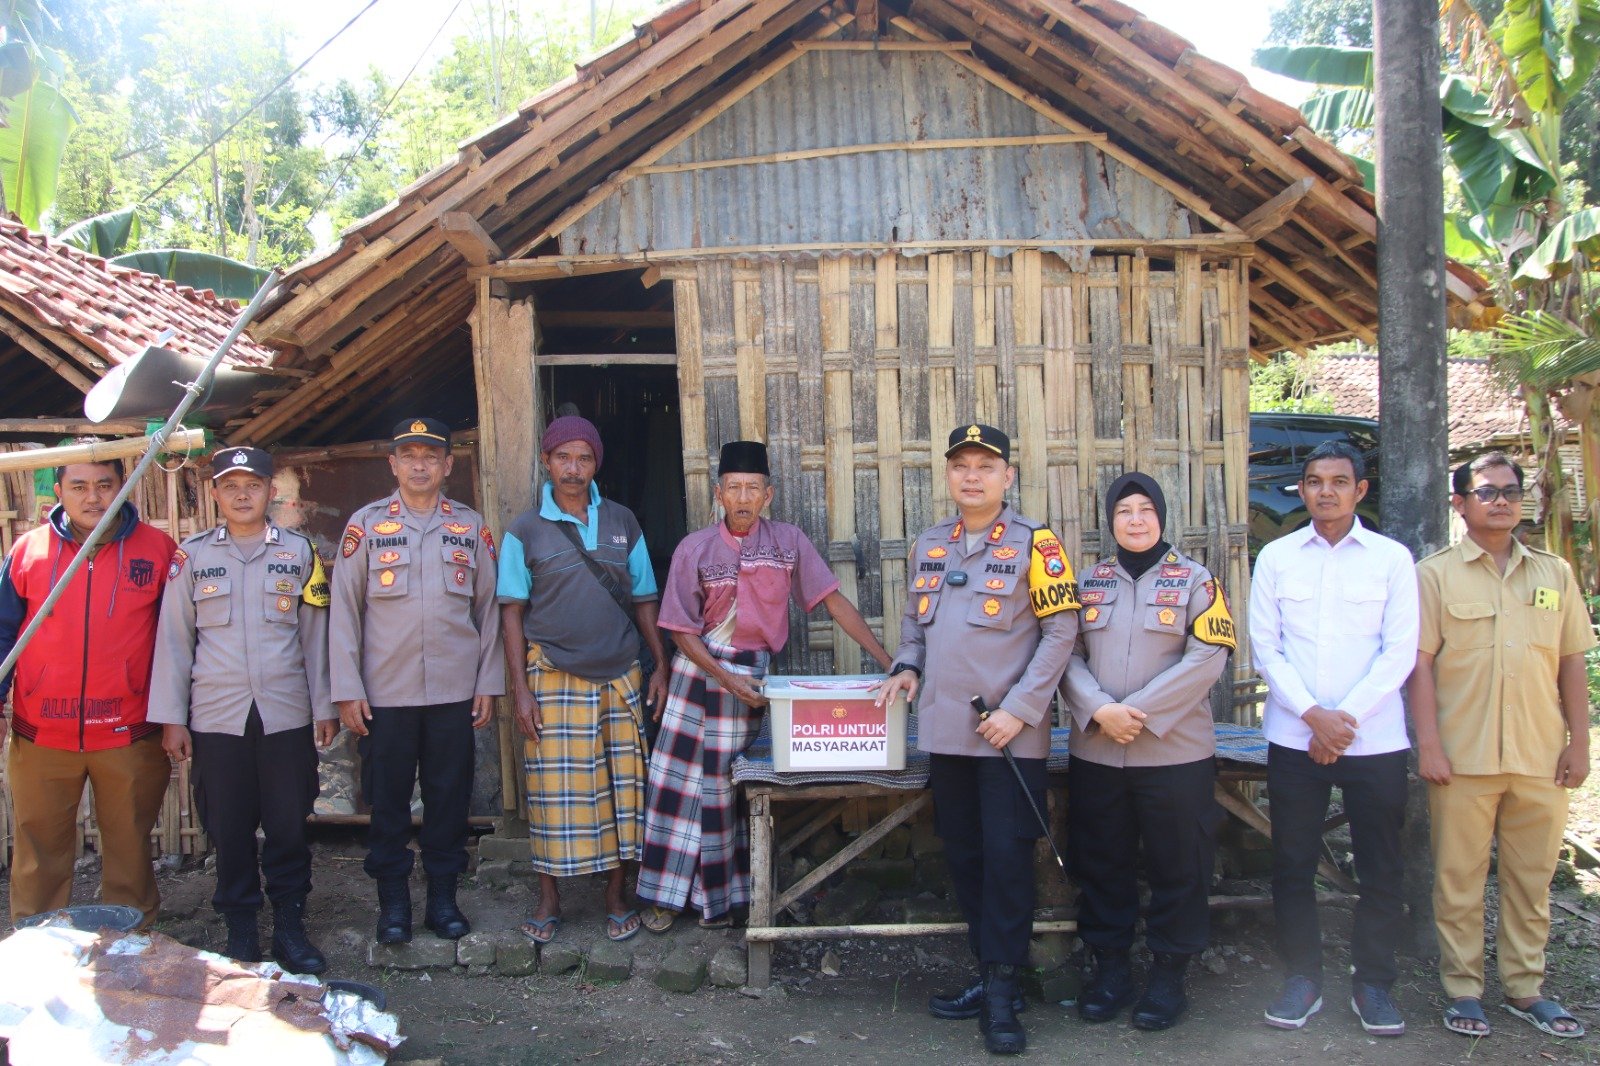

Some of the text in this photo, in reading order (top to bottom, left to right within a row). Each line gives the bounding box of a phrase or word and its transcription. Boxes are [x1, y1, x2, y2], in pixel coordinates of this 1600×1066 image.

[369, 539, 374, 550] F
[442, 535, 475, 549] POLRI
[193, 567, 227, 581] FARID
[268, 564, 301, 576] POLRI
[984, 563, 1017, 574] POLRI
[1083, 579, 1118, 589] WIDIARTI
[1155, 579, 1188, 588] POLRI
[793, 724, 886, 736] POLRI UNTUK
[792, 740, 886, 752] MASYARAKAT
